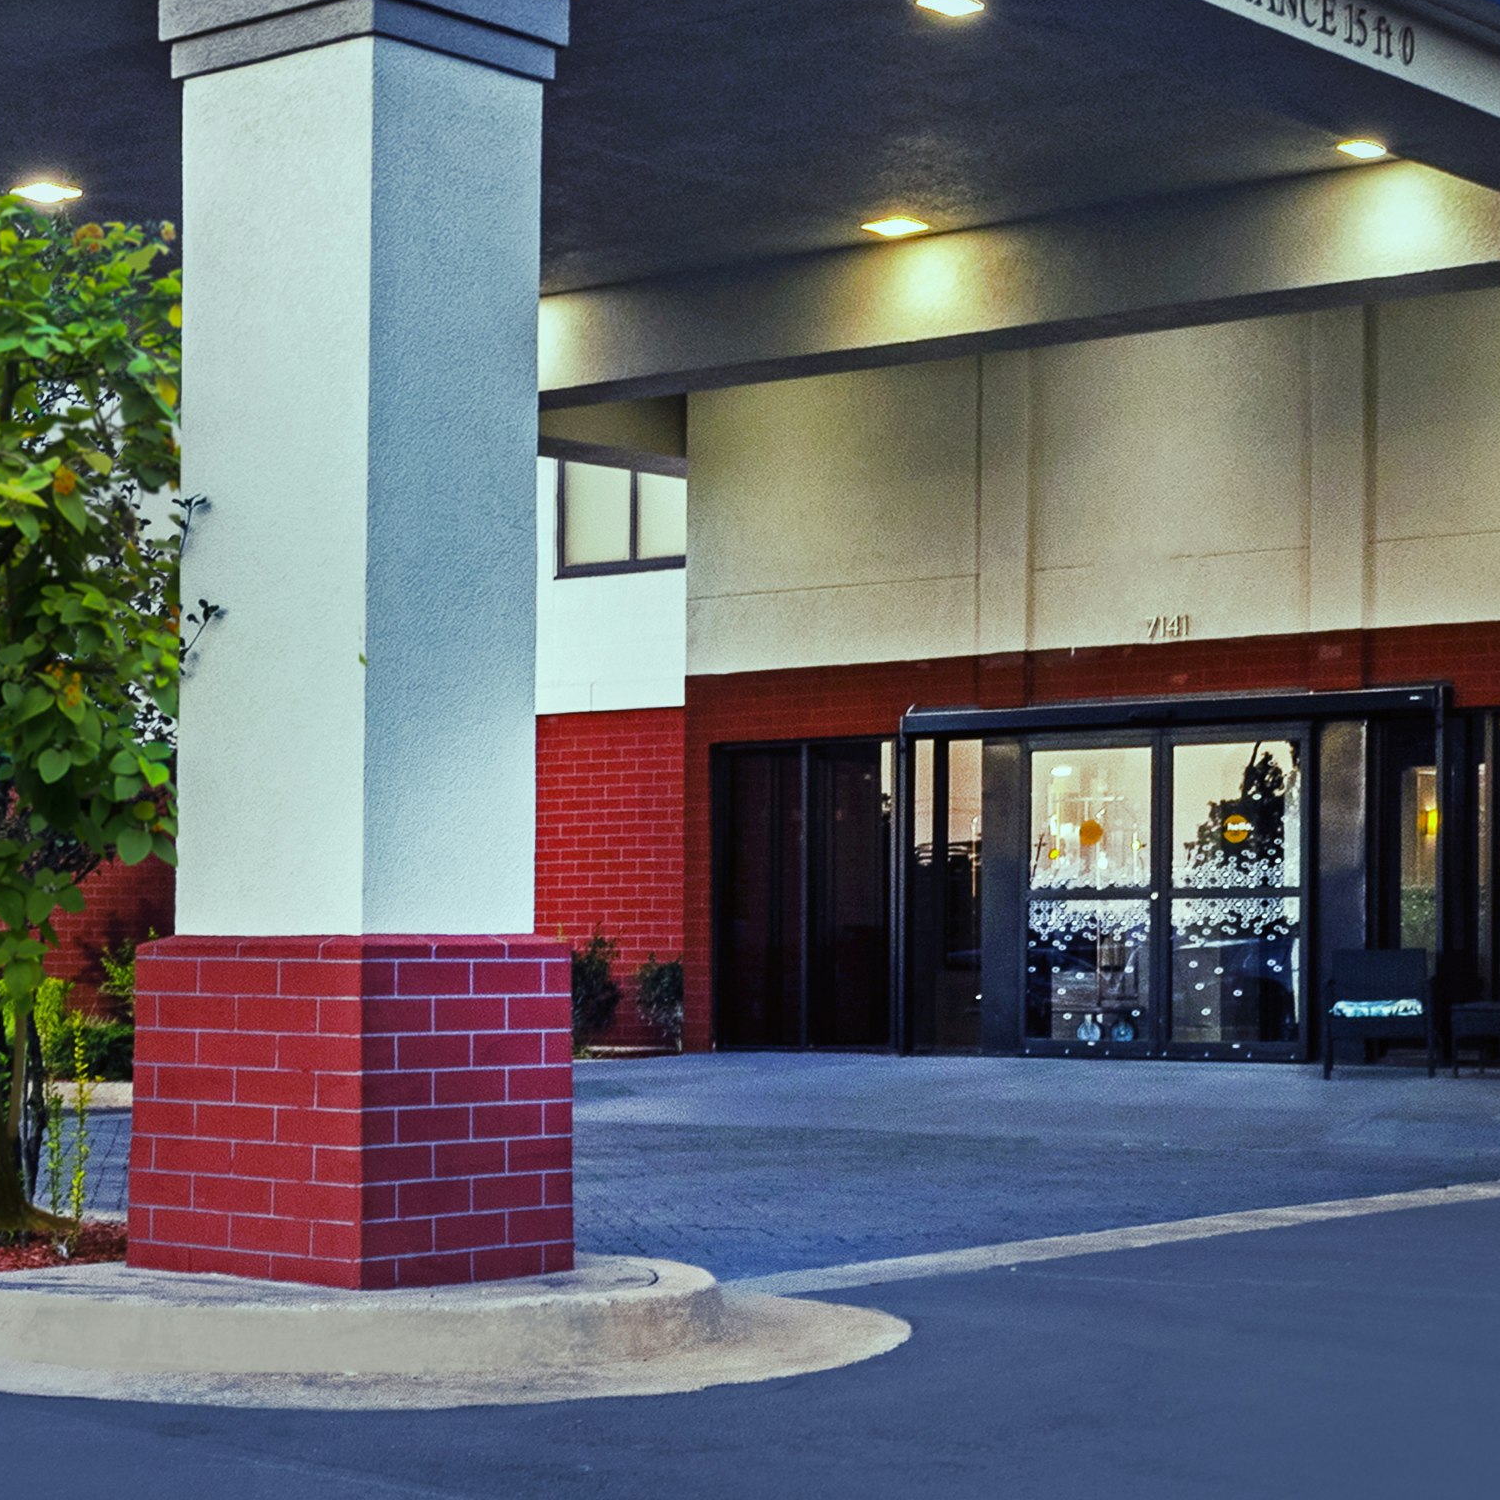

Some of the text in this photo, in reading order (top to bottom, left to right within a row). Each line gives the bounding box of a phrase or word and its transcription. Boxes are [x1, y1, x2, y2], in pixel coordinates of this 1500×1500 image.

[1343, 2, 1368, 48] 15
[1372, 15, 1393, 59] ft
[1145, 612, 1189, 638] 7141
